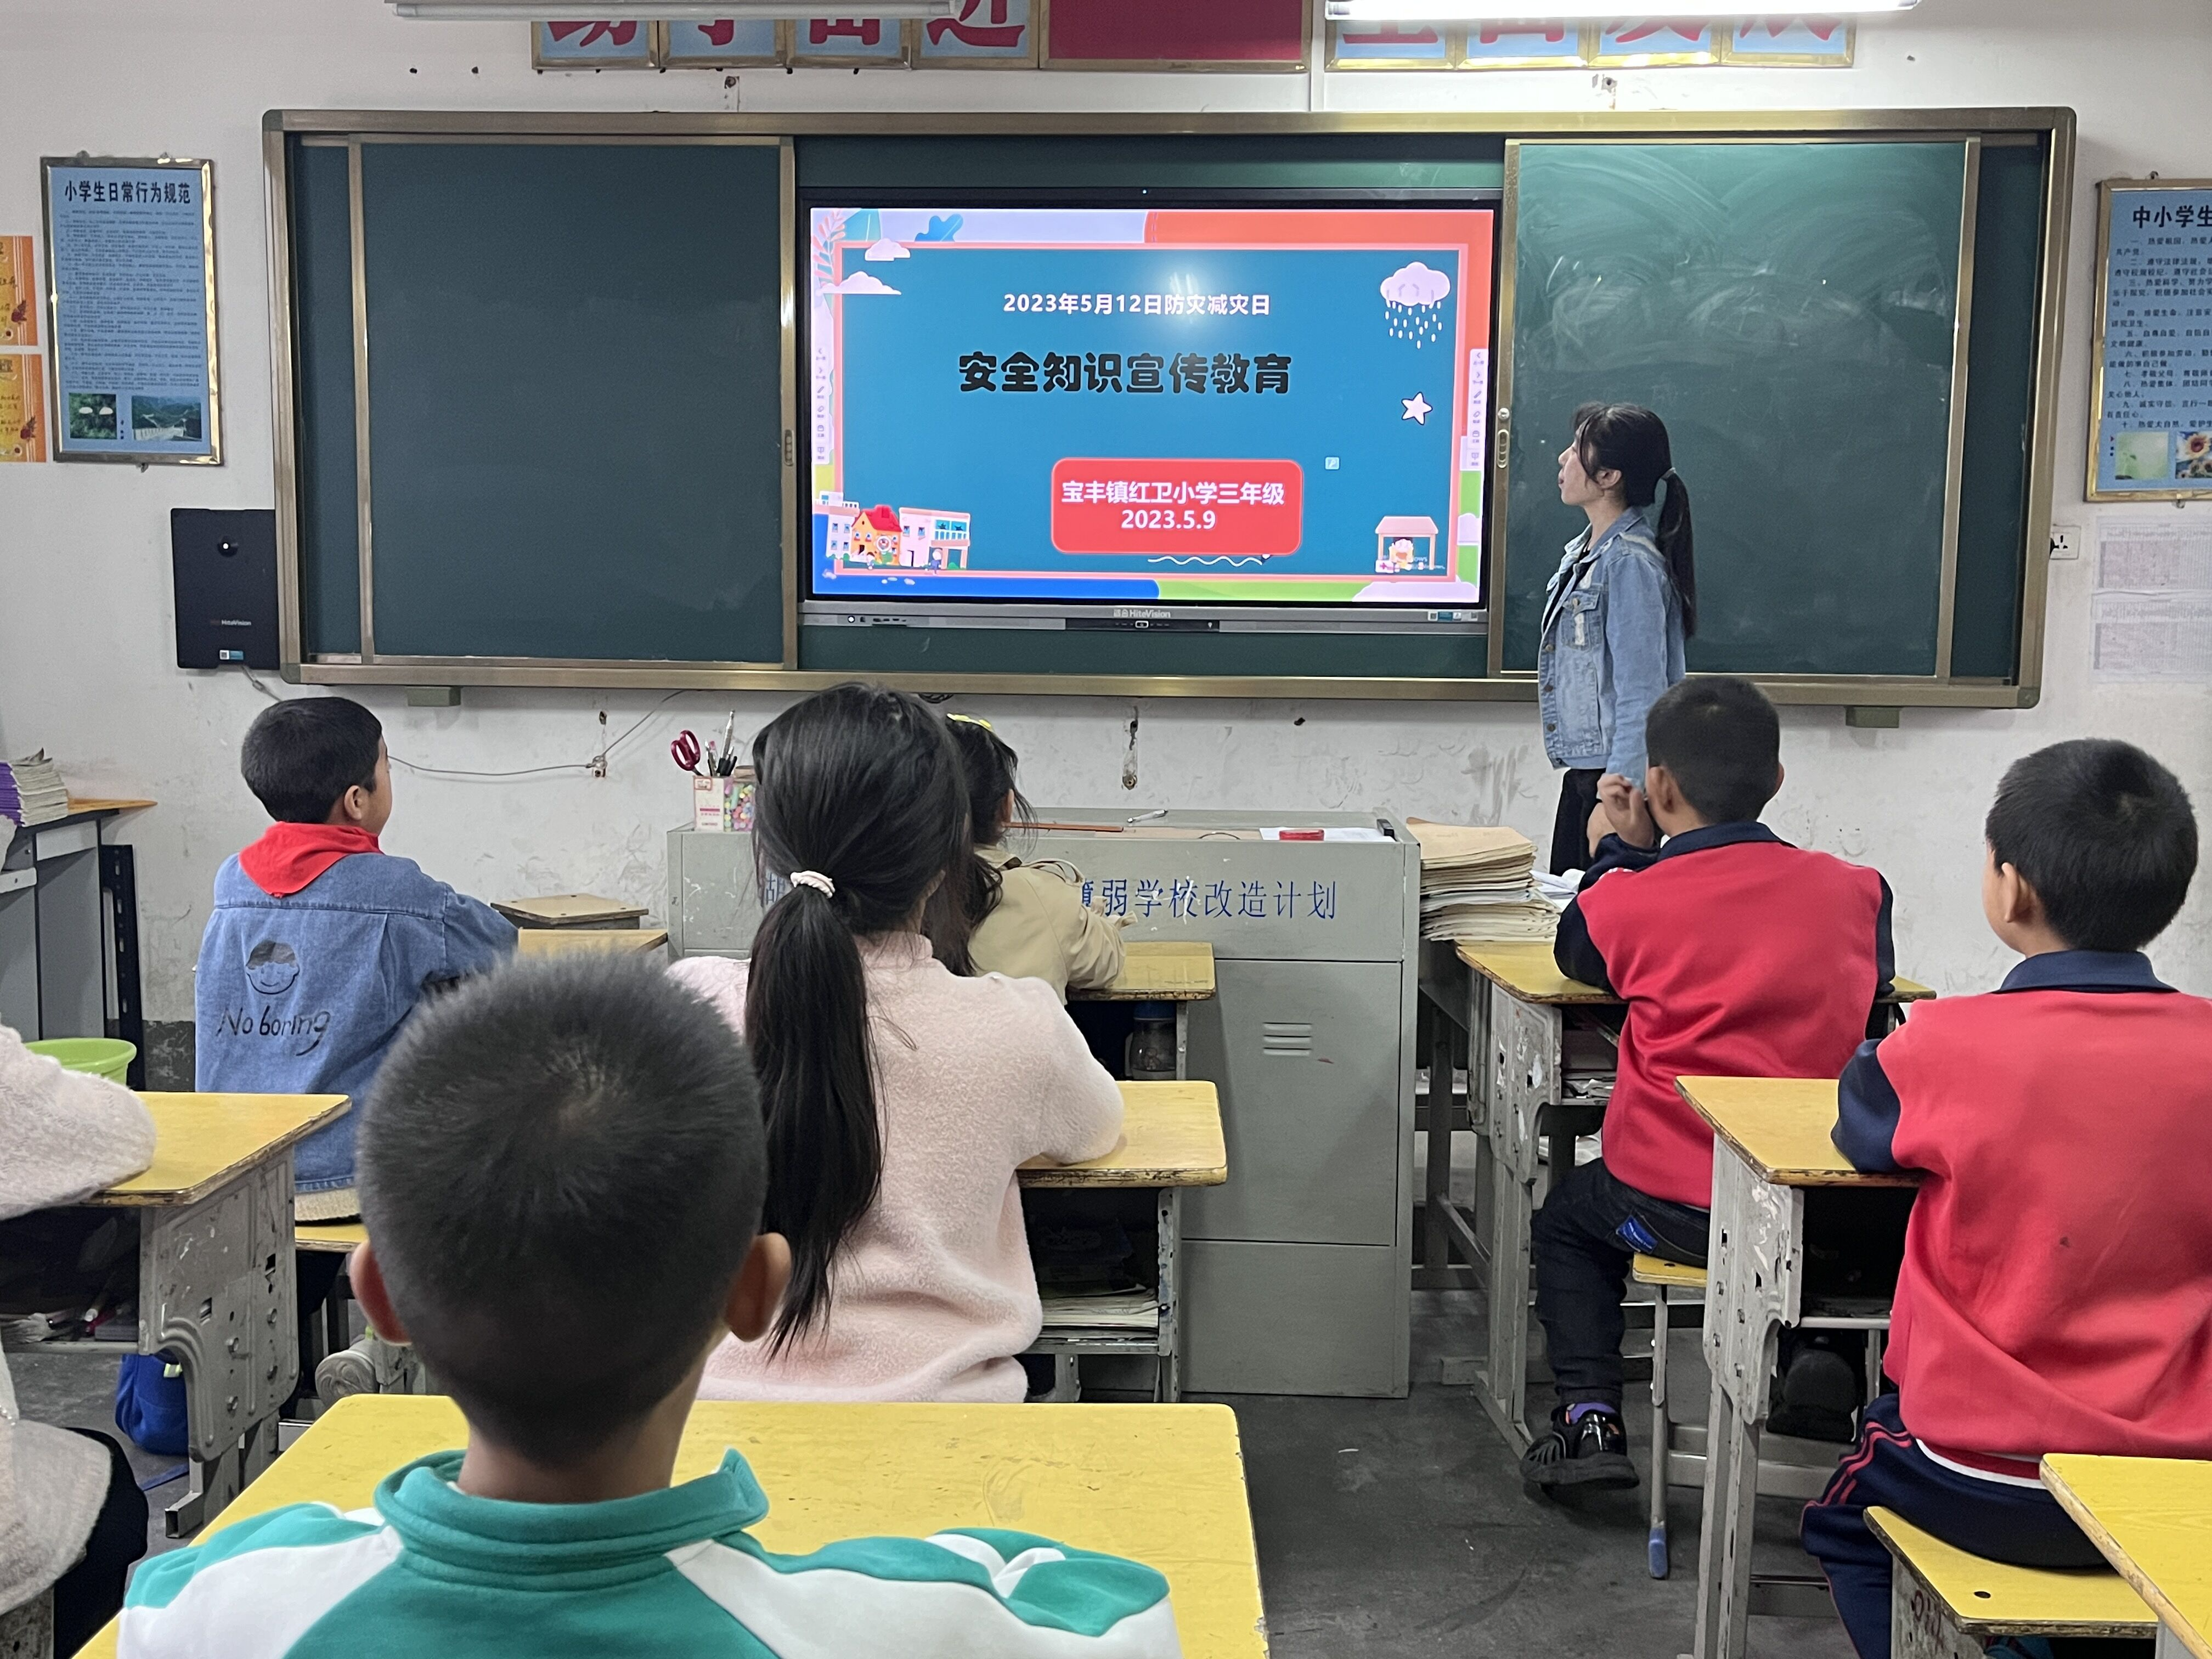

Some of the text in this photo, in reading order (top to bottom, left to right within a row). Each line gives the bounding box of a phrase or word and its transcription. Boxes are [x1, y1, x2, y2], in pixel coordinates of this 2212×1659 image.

[65, 180, 191, 204] 小学生日常行为规范
[2133, 205, 2212, 228] 中小学生
[1003, 292, 1271, 317] 2023年5月12日防灾减灾日
[958, 351, 1292, 395] 安全知识宣传教育
[1062, 481, 1285, 505] 宝丰镇红卫小学三年级
[1121, 510, 1216, 529] 2023.5.9
[1129, 609, 1171, 618] HiteVision
[216, 1007, 253, 1036] No
